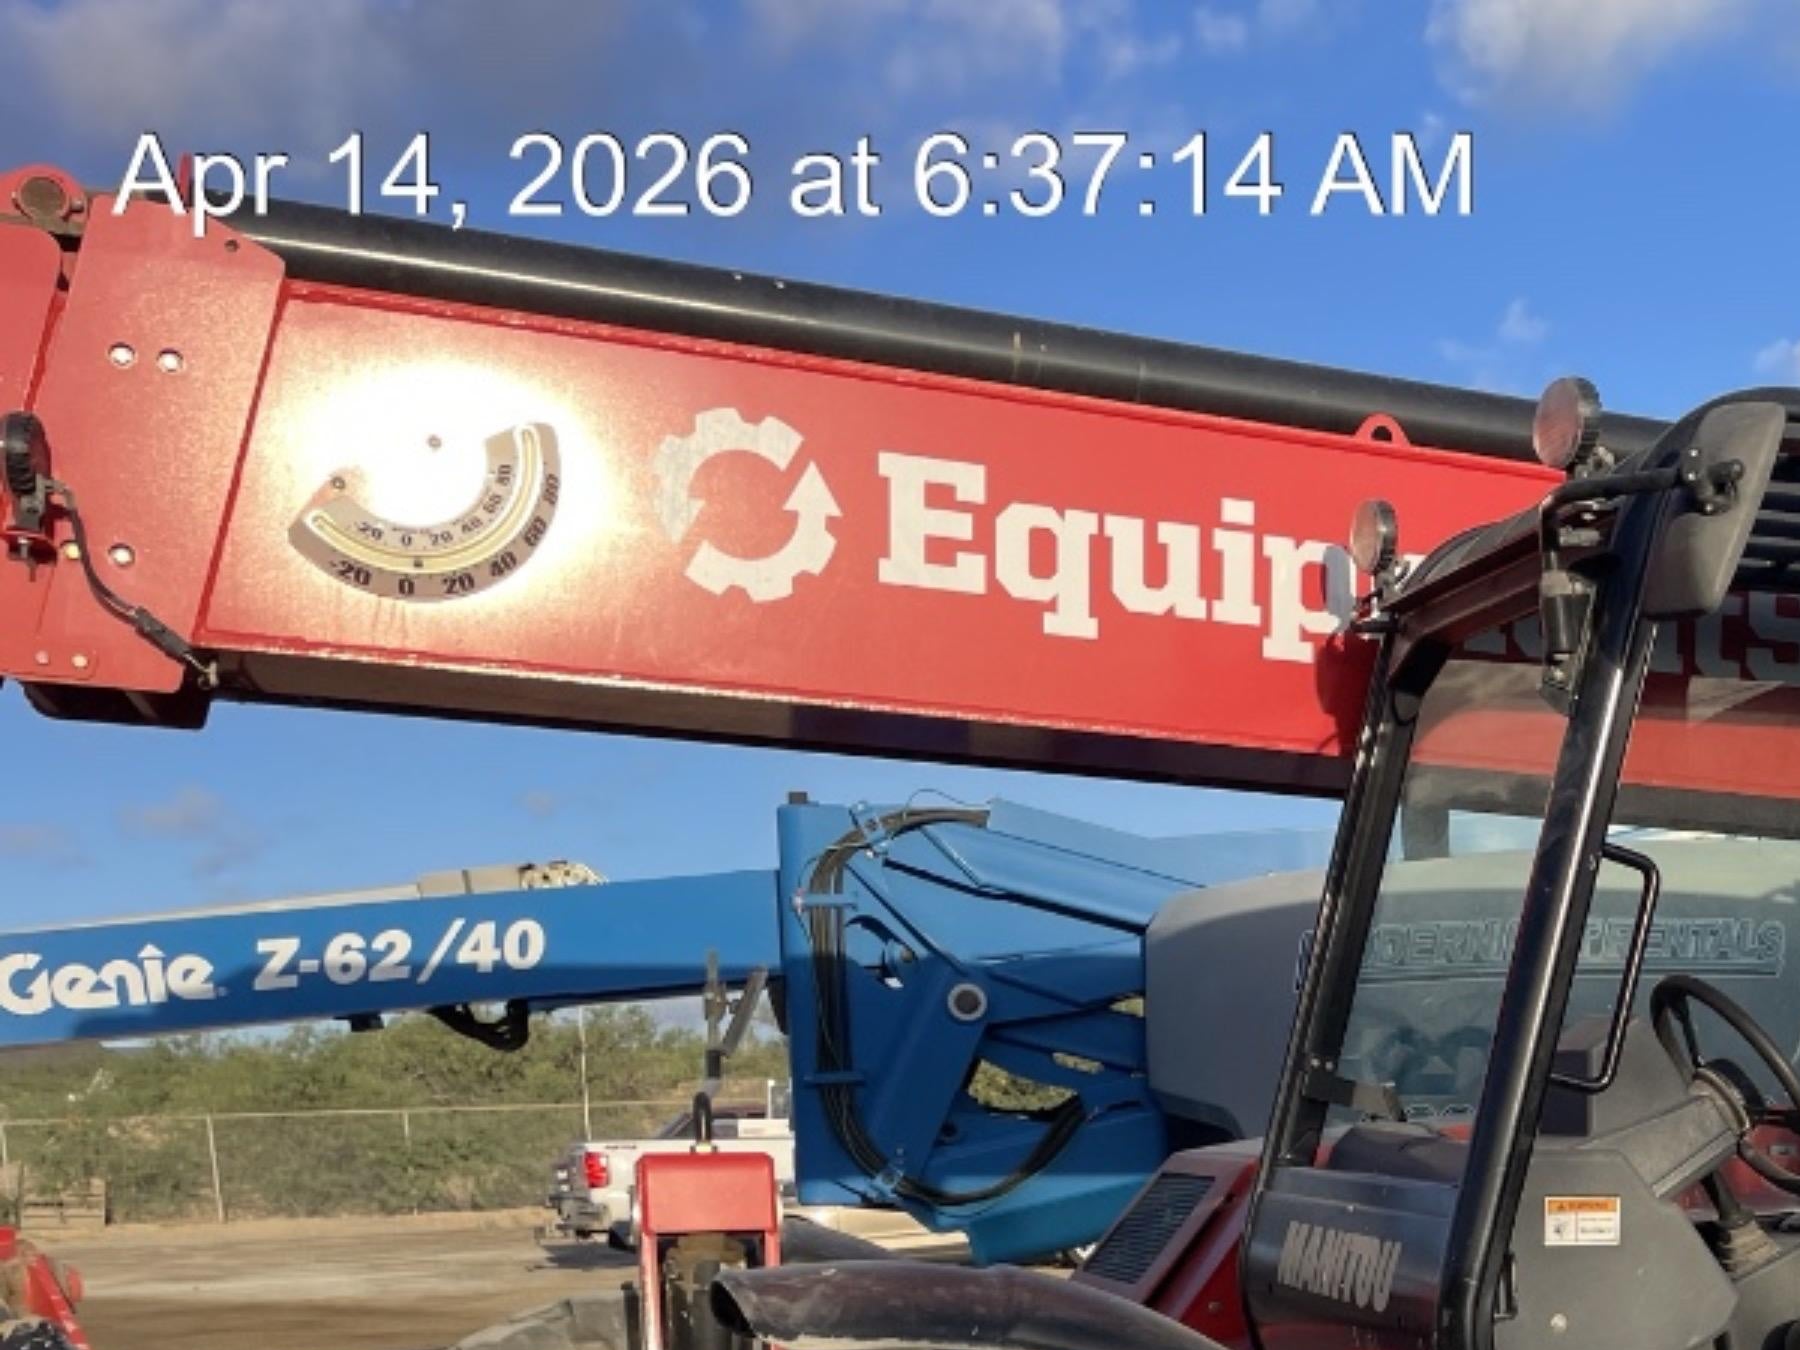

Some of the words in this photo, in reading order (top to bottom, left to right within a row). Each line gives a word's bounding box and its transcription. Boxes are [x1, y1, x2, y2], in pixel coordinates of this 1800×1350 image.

[398, 575, 416, 596] 0
[440, 572, 476, 595] 20
[488, 550, 518, 579] 40
[523, 514, 548, 548] 60
[543, 472, 560, 506] 80
[0, 942, 216, 1016] Genie
[252, 917, 547, 993] Z-62/40
[1278, 1220, 1402, 1313] MANITOU
